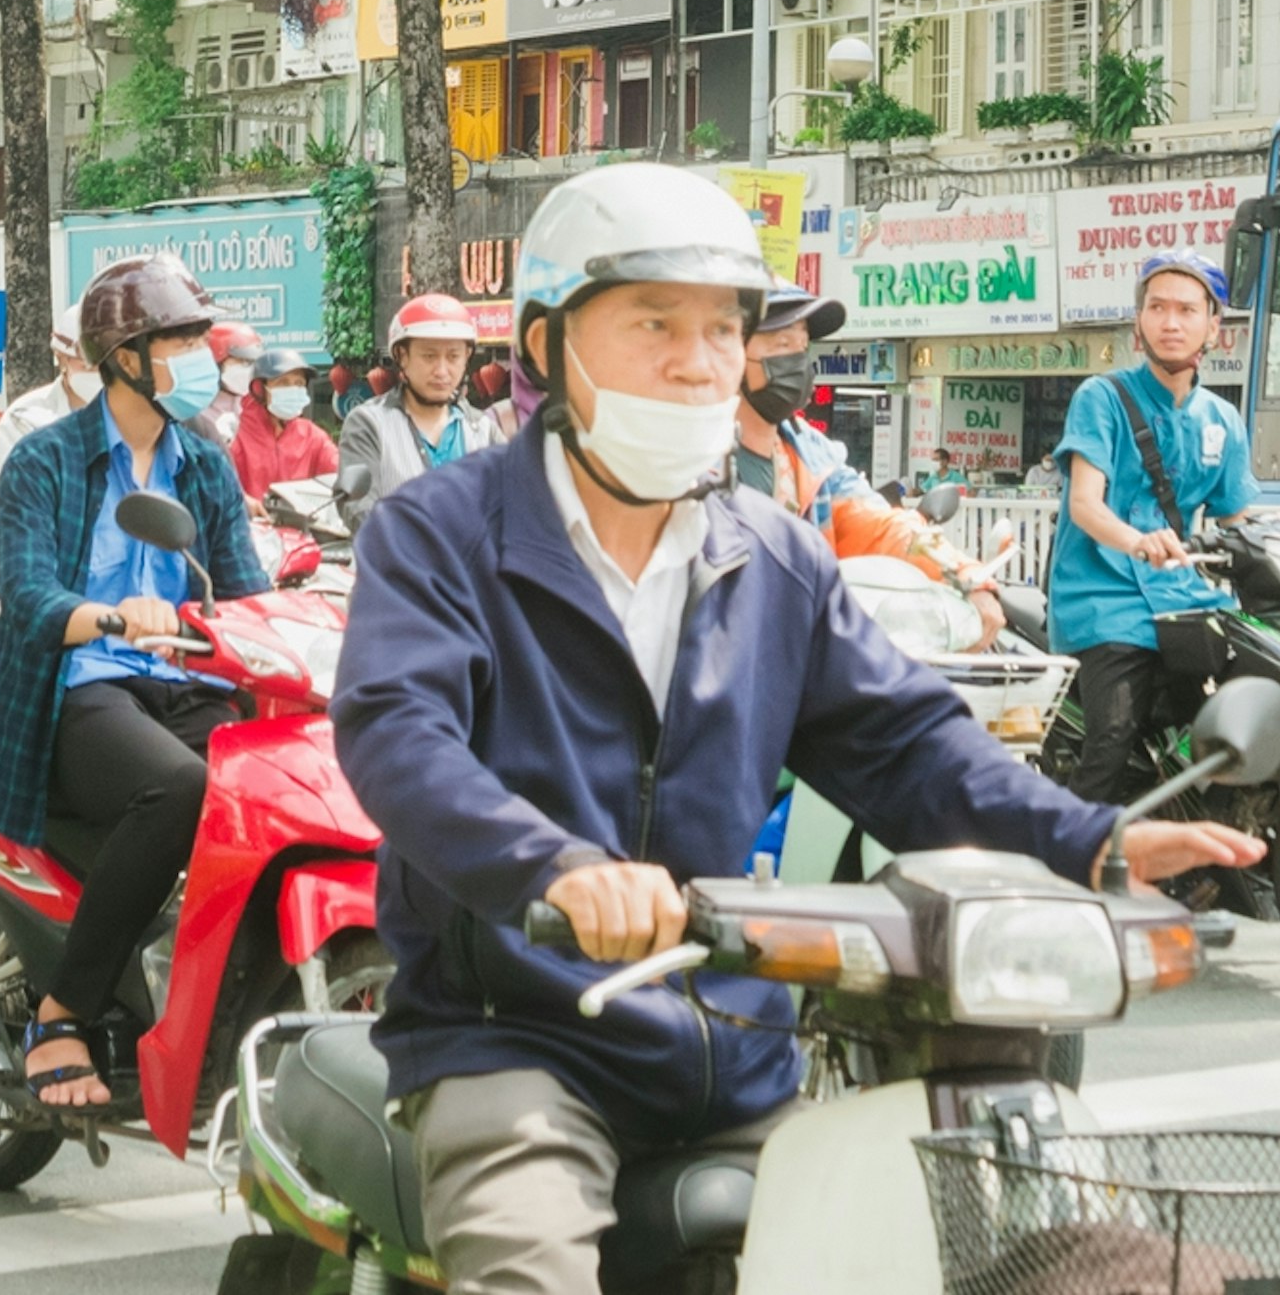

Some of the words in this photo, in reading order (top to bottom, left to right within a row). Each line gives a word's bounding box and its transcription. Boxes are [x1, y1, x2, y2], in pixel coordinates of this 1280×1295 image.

[1109, 191, 1183, 217] TRUNG
[1188, 181, 1236, 211] TÂM
[187, 229, 214, 272] TỎI
[218, 230, 242, 271] CÔ
[245, 225, 295, 269] BỐNG
[1078, 224, 1142, 257] DỤNG
[1183, 222, 1198, 246] Y
[853, 259, 969, 306] TRANG
[976, 244, 1036, 304] ĐÀI
[1119, 262, 1128, 276] Y
[947, 342, 1036, 370] TRANG
[1039, 339, 1088, 369] ĐÀI
[947, 381, 1020, 403] TRANG
[965, 405, 1000, 429] ĐÀI
